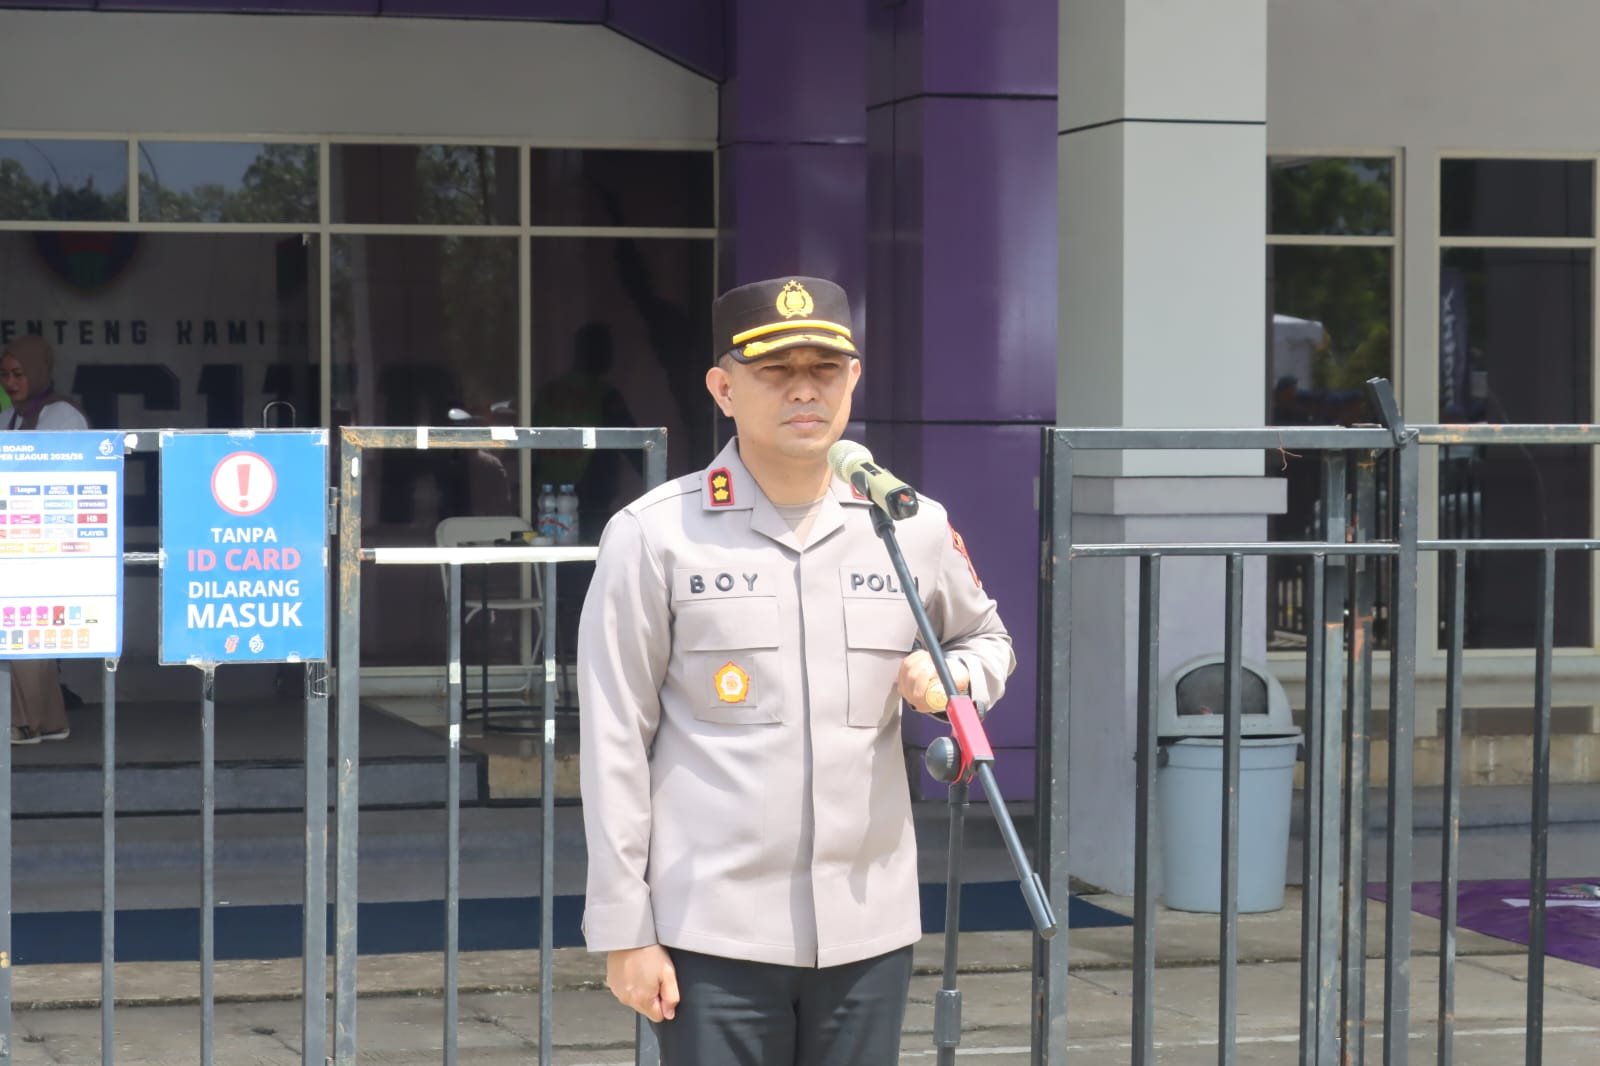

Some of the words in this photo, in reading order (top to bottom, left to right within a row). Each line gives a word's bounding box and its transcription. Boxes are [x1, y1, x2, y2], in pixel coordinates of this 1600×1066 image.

[177, 320, 265, 344] KAMI
[3, 445, 34, 453] BOARD
[211, 527, 278, 544] TANPA
[188, 549, 216, 571] ID
[225, 547, 300, 571] CARD
[188, 580, 299, 598] DILARANG
[690, 572, 758, 593] BOY
[851, 574, 919, 593] POLI
[187, 602, 303, 629] MASUK
